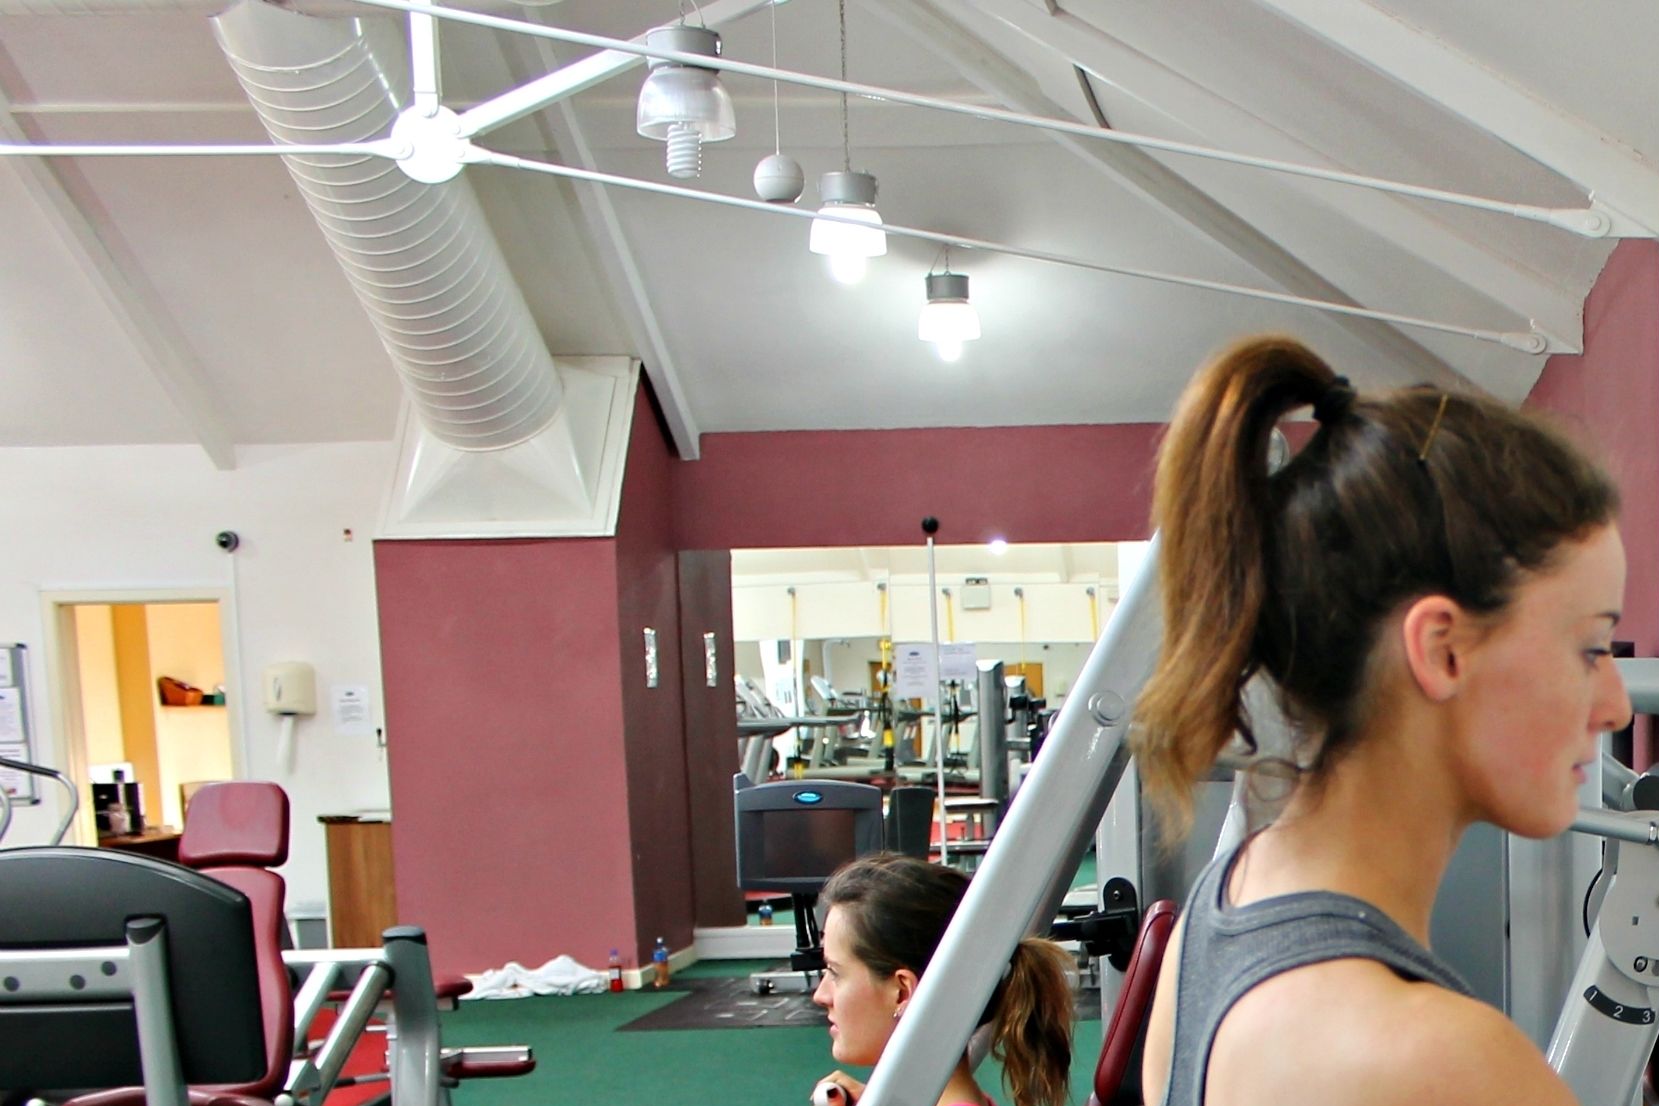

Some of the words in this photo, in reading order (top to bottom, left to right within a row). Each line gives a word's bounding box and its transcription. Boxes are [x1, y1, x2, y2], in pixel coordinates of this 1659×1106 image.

[1589, 990, 1598, 1001] 1
[1613, 1004, 1624, 1018] 2
[1642, 1010, 1651, 1023] 3
